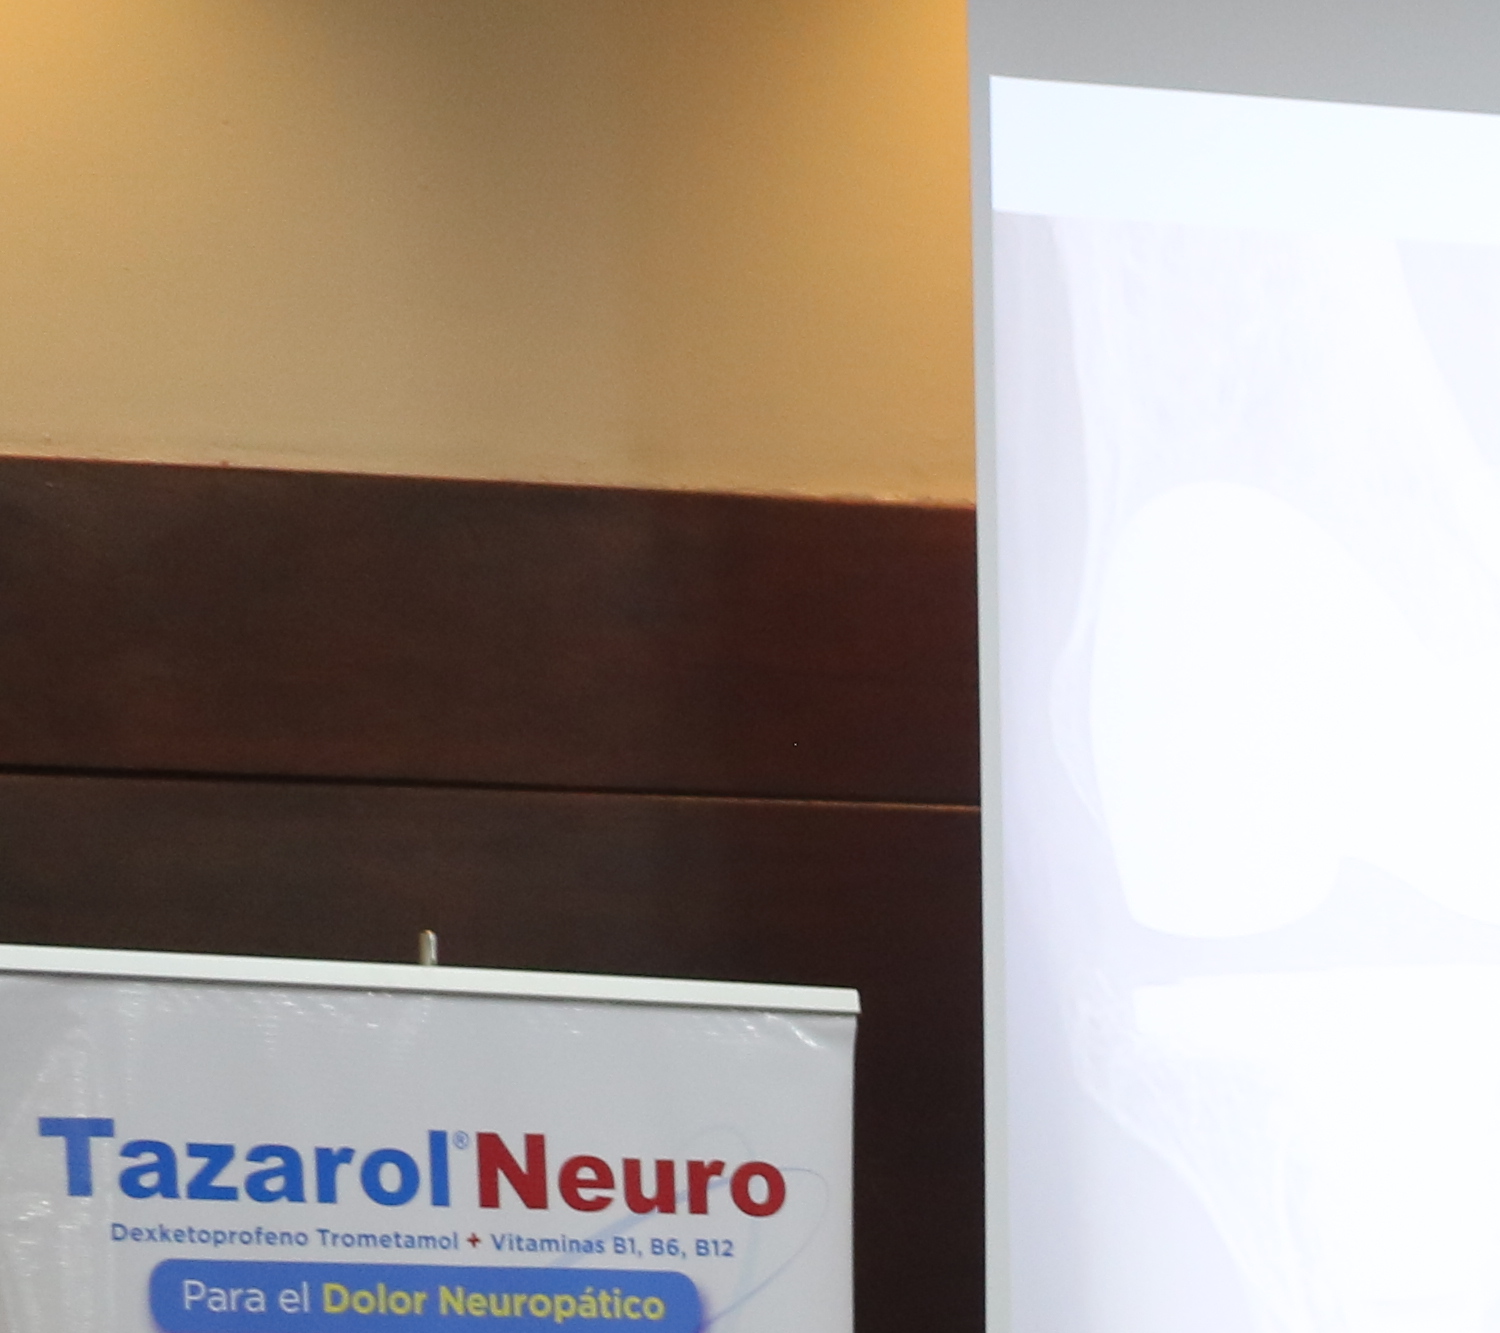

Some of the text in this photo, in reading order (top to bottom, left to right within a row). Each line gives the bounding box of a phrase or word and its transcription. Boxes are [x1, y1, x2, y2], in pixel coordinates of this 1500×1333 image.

[478, 1132, 786, 1217] Neuro
[111, 1223, 308, 1250] Dexketoprofeno
[317, 1229, 459, 1251] Trometamol
[491, 1233, 605, 1255] Vitaminas
[613, 1235, 643, 1259] B1,
[650, 1237, 687, 1260] B6,
[696, 1239, 734, 1258] B12
[183, 1281, 665, 1329] Para el Dolor Neuropático
